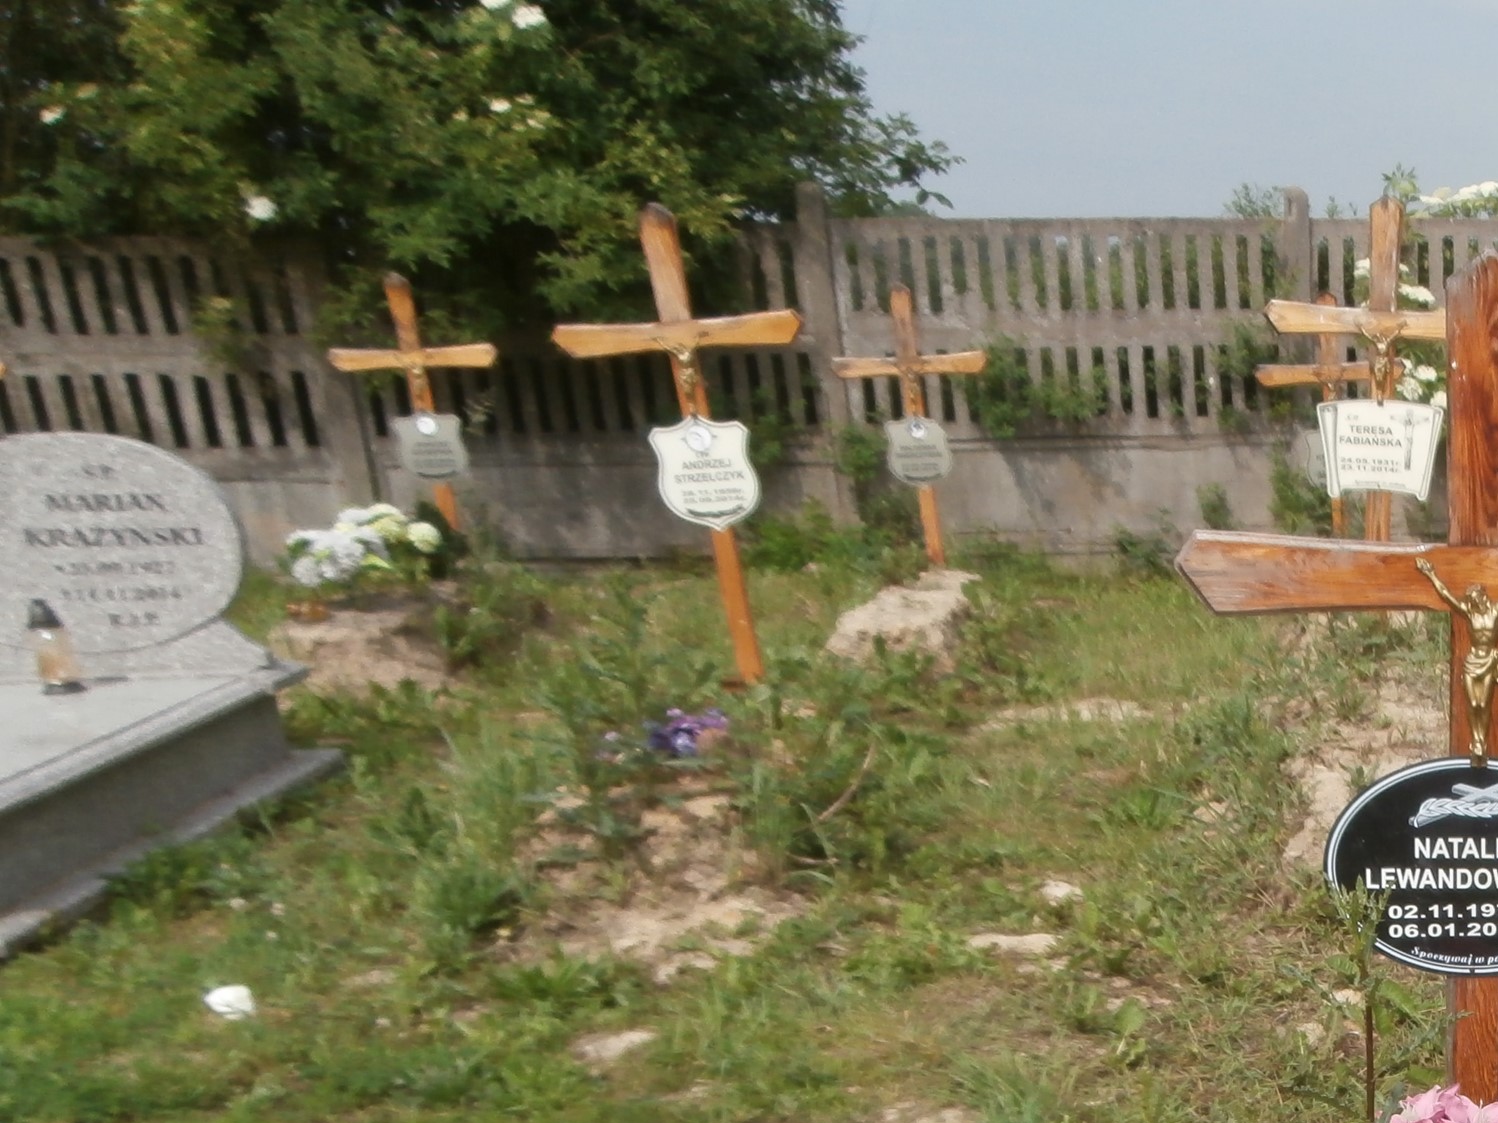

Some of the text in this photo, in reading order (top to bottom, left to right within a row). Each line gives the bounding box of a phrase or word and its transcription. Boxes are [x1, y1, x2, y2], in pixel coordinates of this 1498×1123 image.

[1349, 424, 1394, 435] TERESA
[681, 458, 732, 470] ANDRZEJ
[1411, 946, 1473, 966] Spoczywaj
